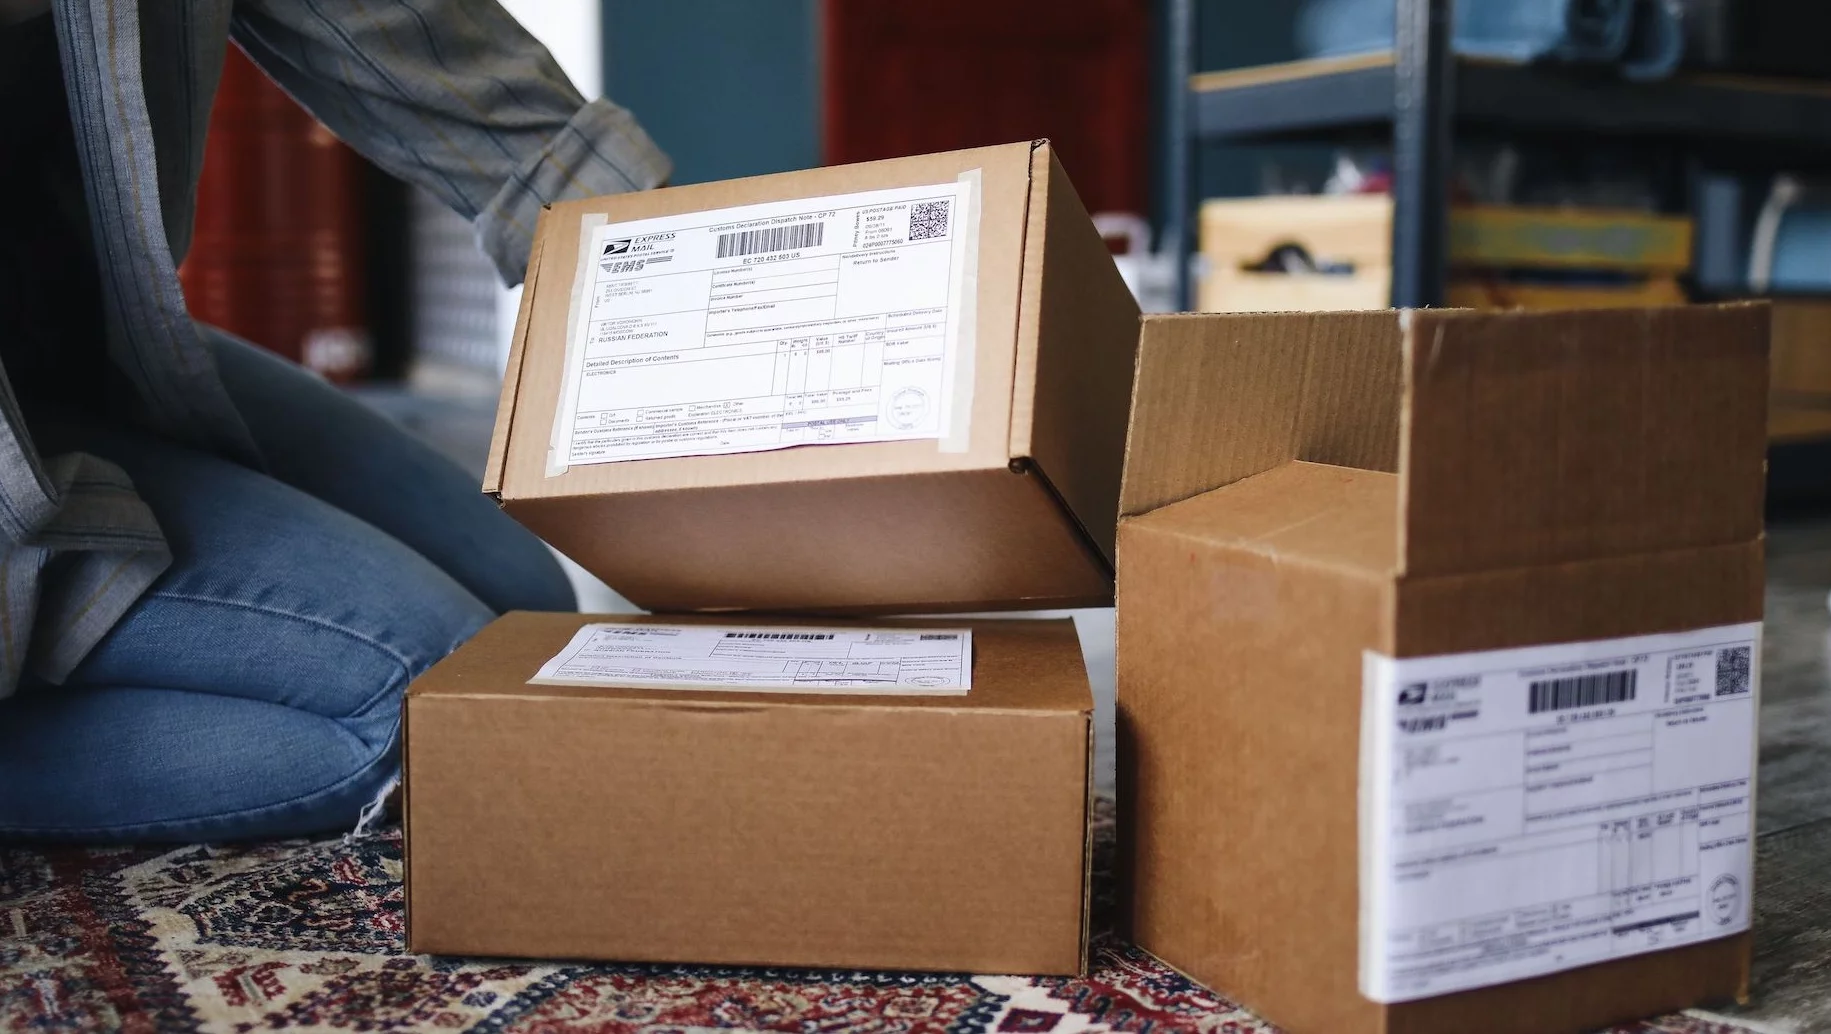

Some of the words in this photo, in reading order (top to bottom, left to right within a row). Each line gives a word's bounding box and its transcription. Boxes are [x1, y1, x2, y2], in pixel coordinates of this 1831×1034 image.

[709, 224, 734, 232] Customs
[736, 220, 768, 228] Declaration
[771, 216, 796, 224] Dispatch
[634, 233, 676, 243] EXPRESS
[631, 244, 654, 252] MAIL
[612, 259, 645, 273] EMS
[627, 330, 668, 339] FEDERATION
[610, 357, 643, 365] Description
[652, 353, 679, 361] Contents
